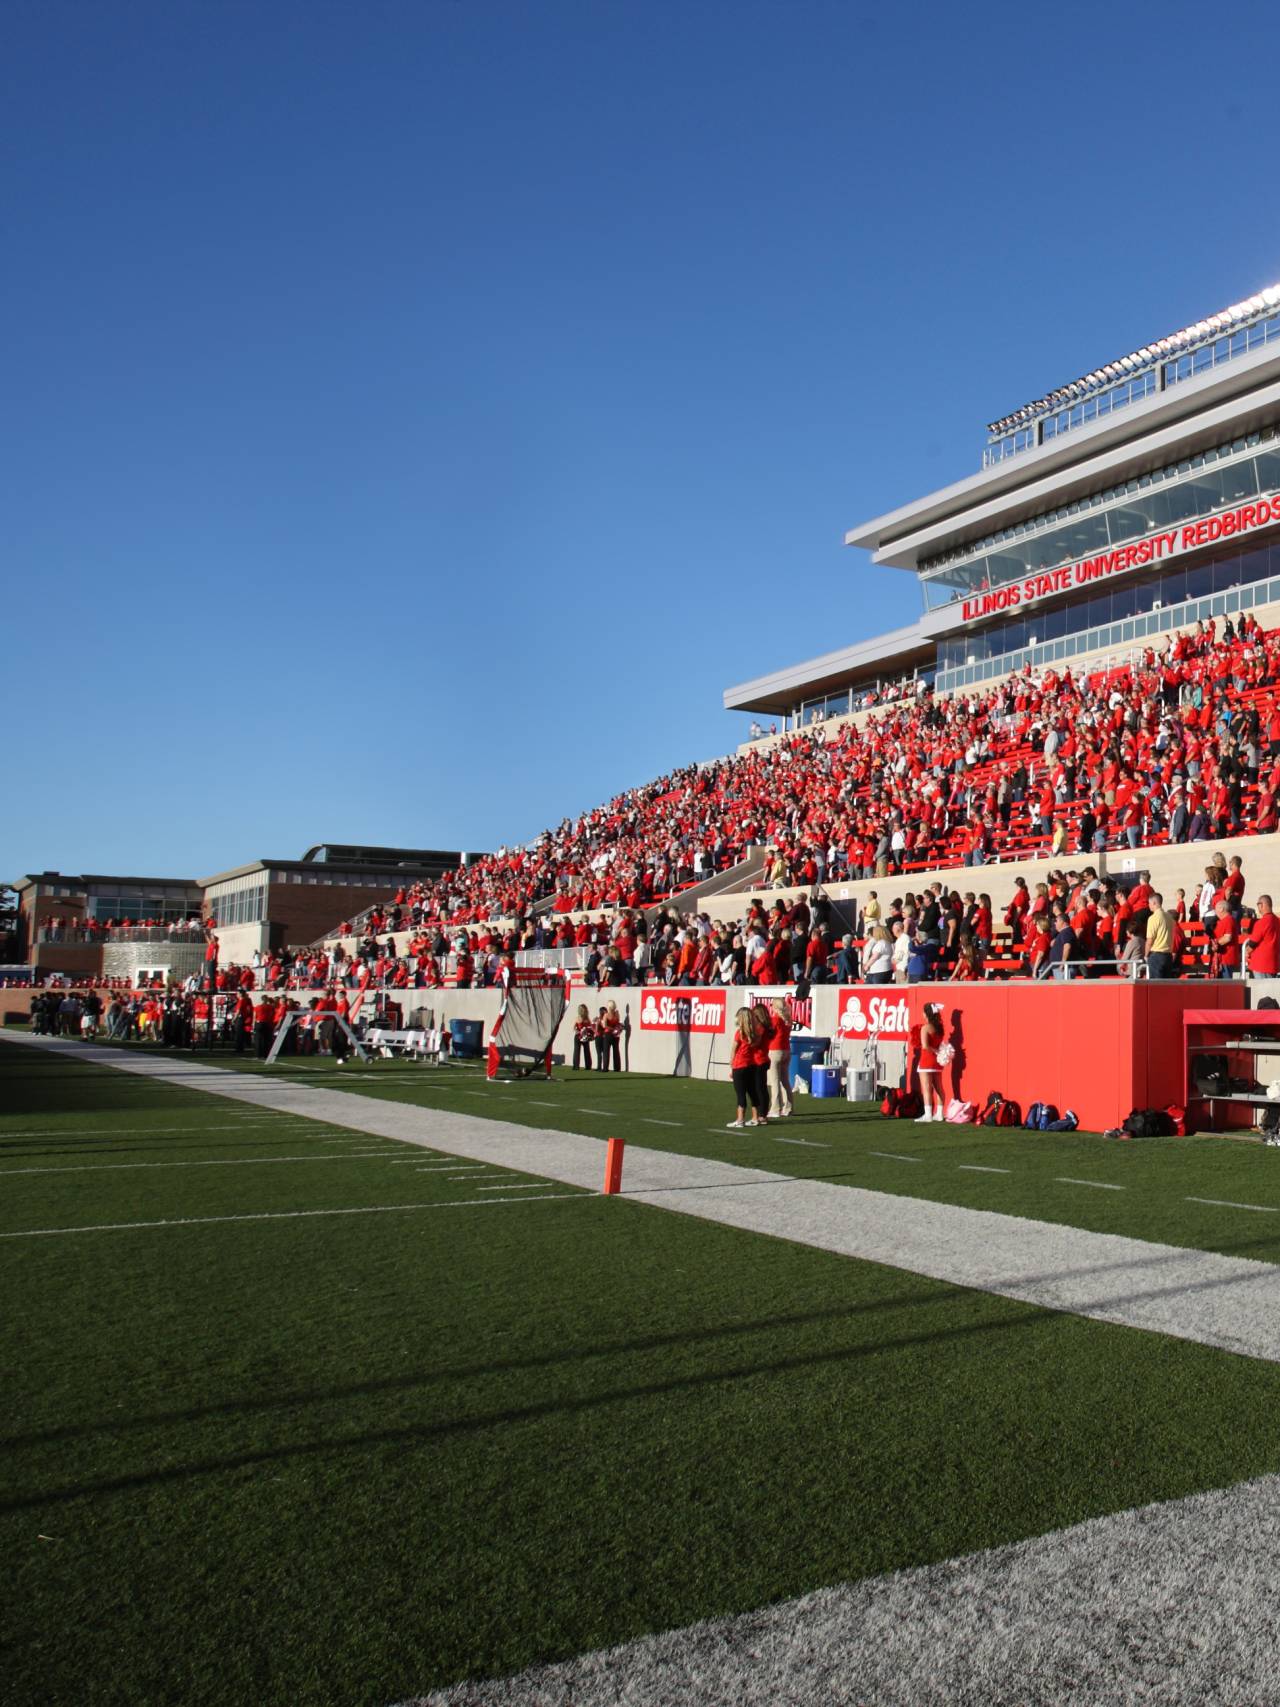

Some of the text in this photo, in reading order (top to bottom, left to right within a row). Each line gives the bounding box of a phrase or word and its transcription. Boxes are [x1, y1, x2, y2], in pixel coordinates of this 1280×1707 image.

[962, 585, 1021, 621] ILLINOIS
[1024, 567, 1072, 600] STATE
[1075, 531, 1178, 583] UNIVERSITY
